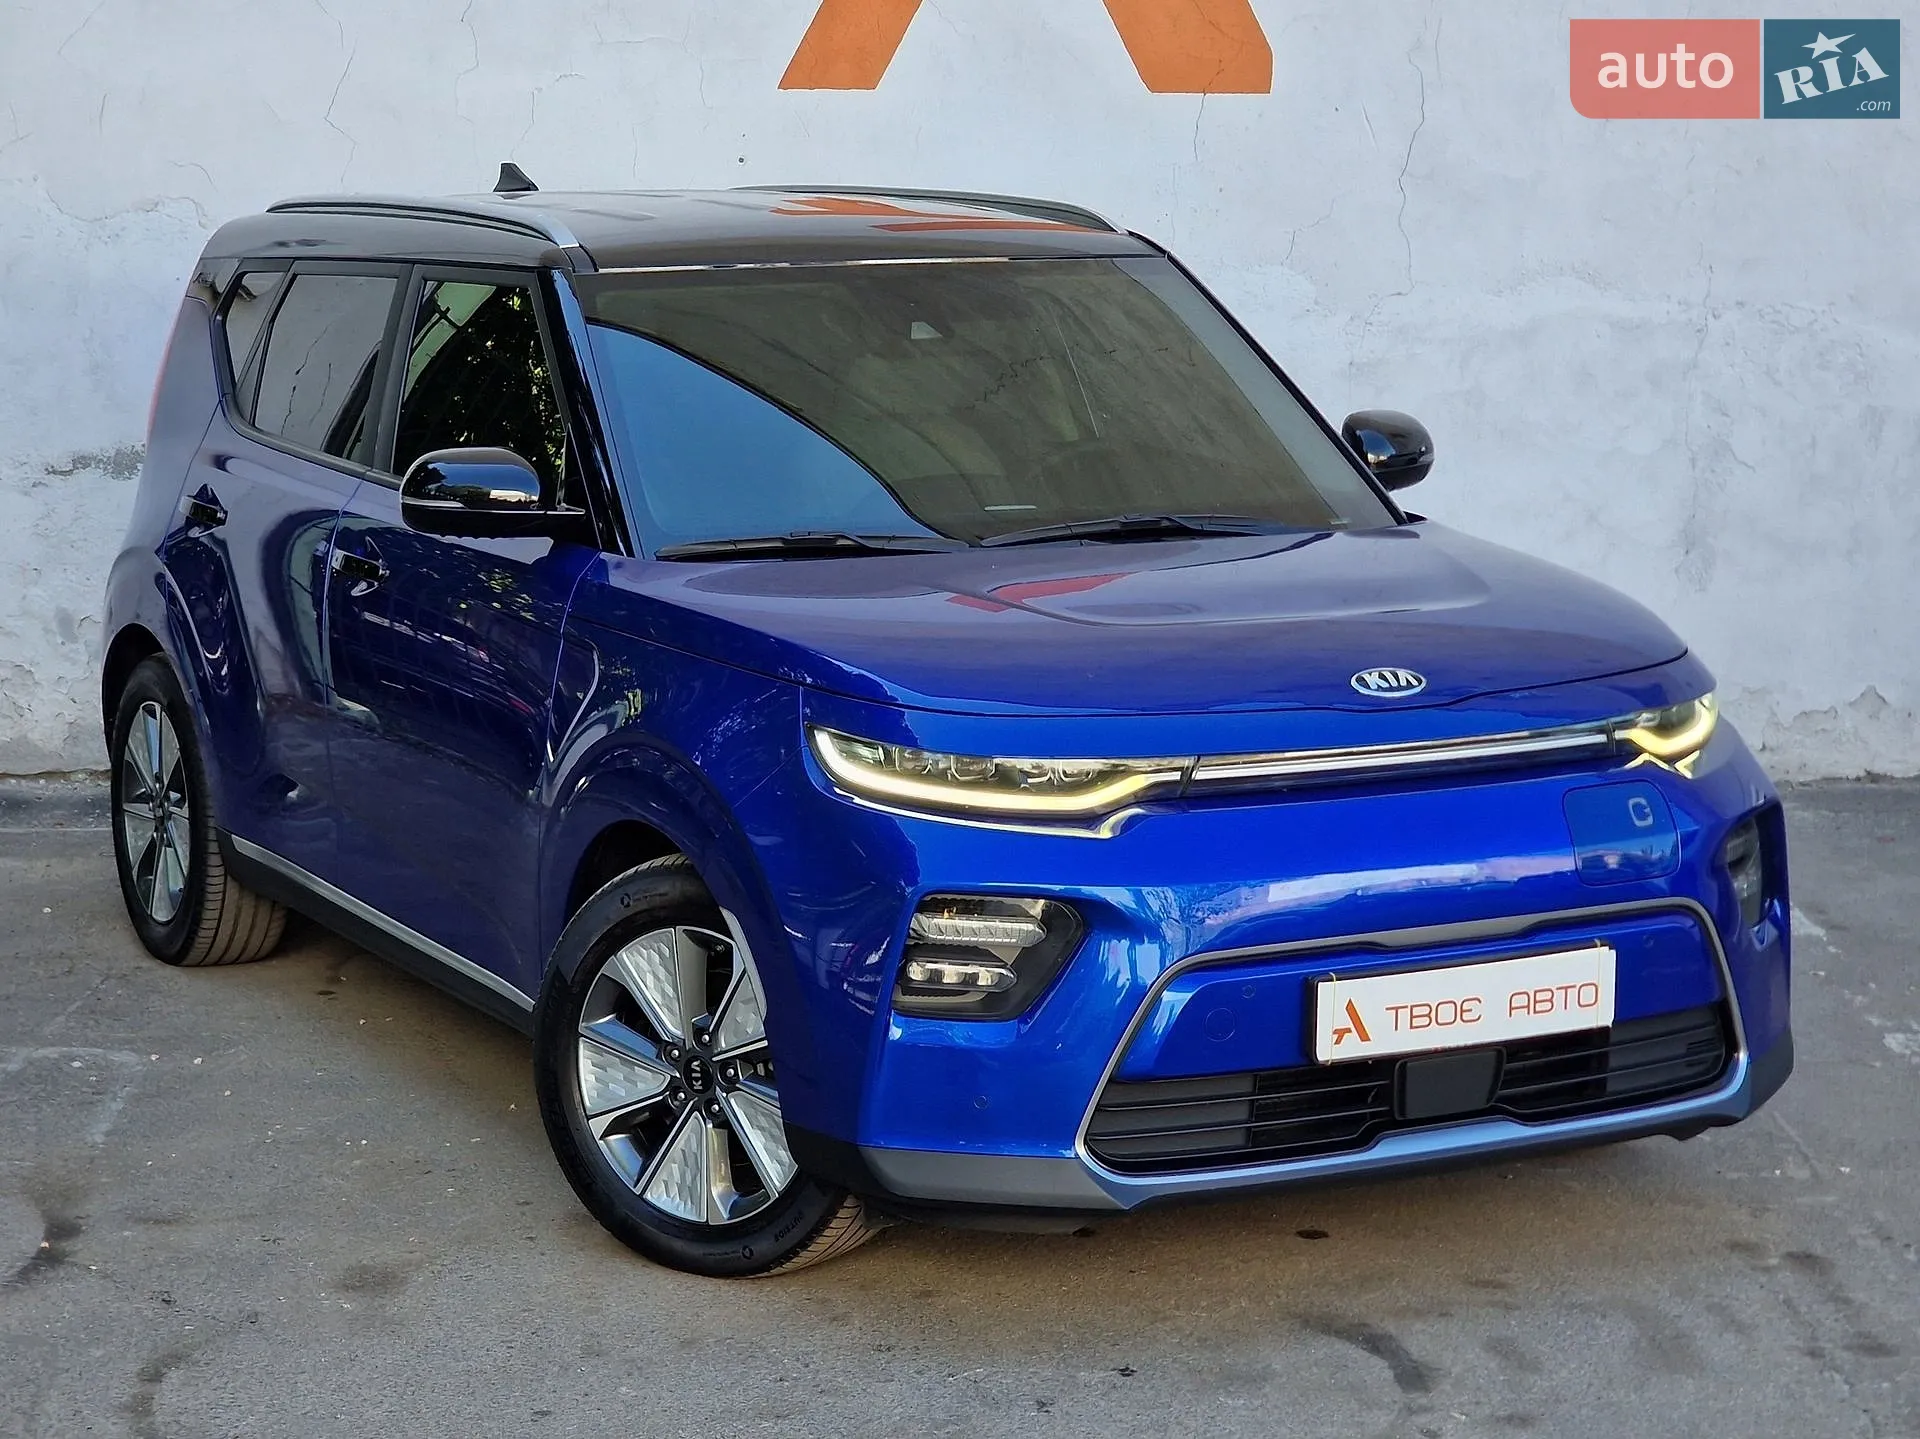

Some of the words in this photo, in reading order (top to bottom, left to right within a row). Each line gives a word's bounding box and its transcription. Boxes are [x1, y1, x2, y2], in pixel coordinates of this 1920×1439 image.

[1361, 670, 1419, 690] KIA
[1385, 997, 1483, 1032] ТВОЄ
[1508, 982, 1599, 1018] АВТО
[691, 1060, 703, 1090] KIA
